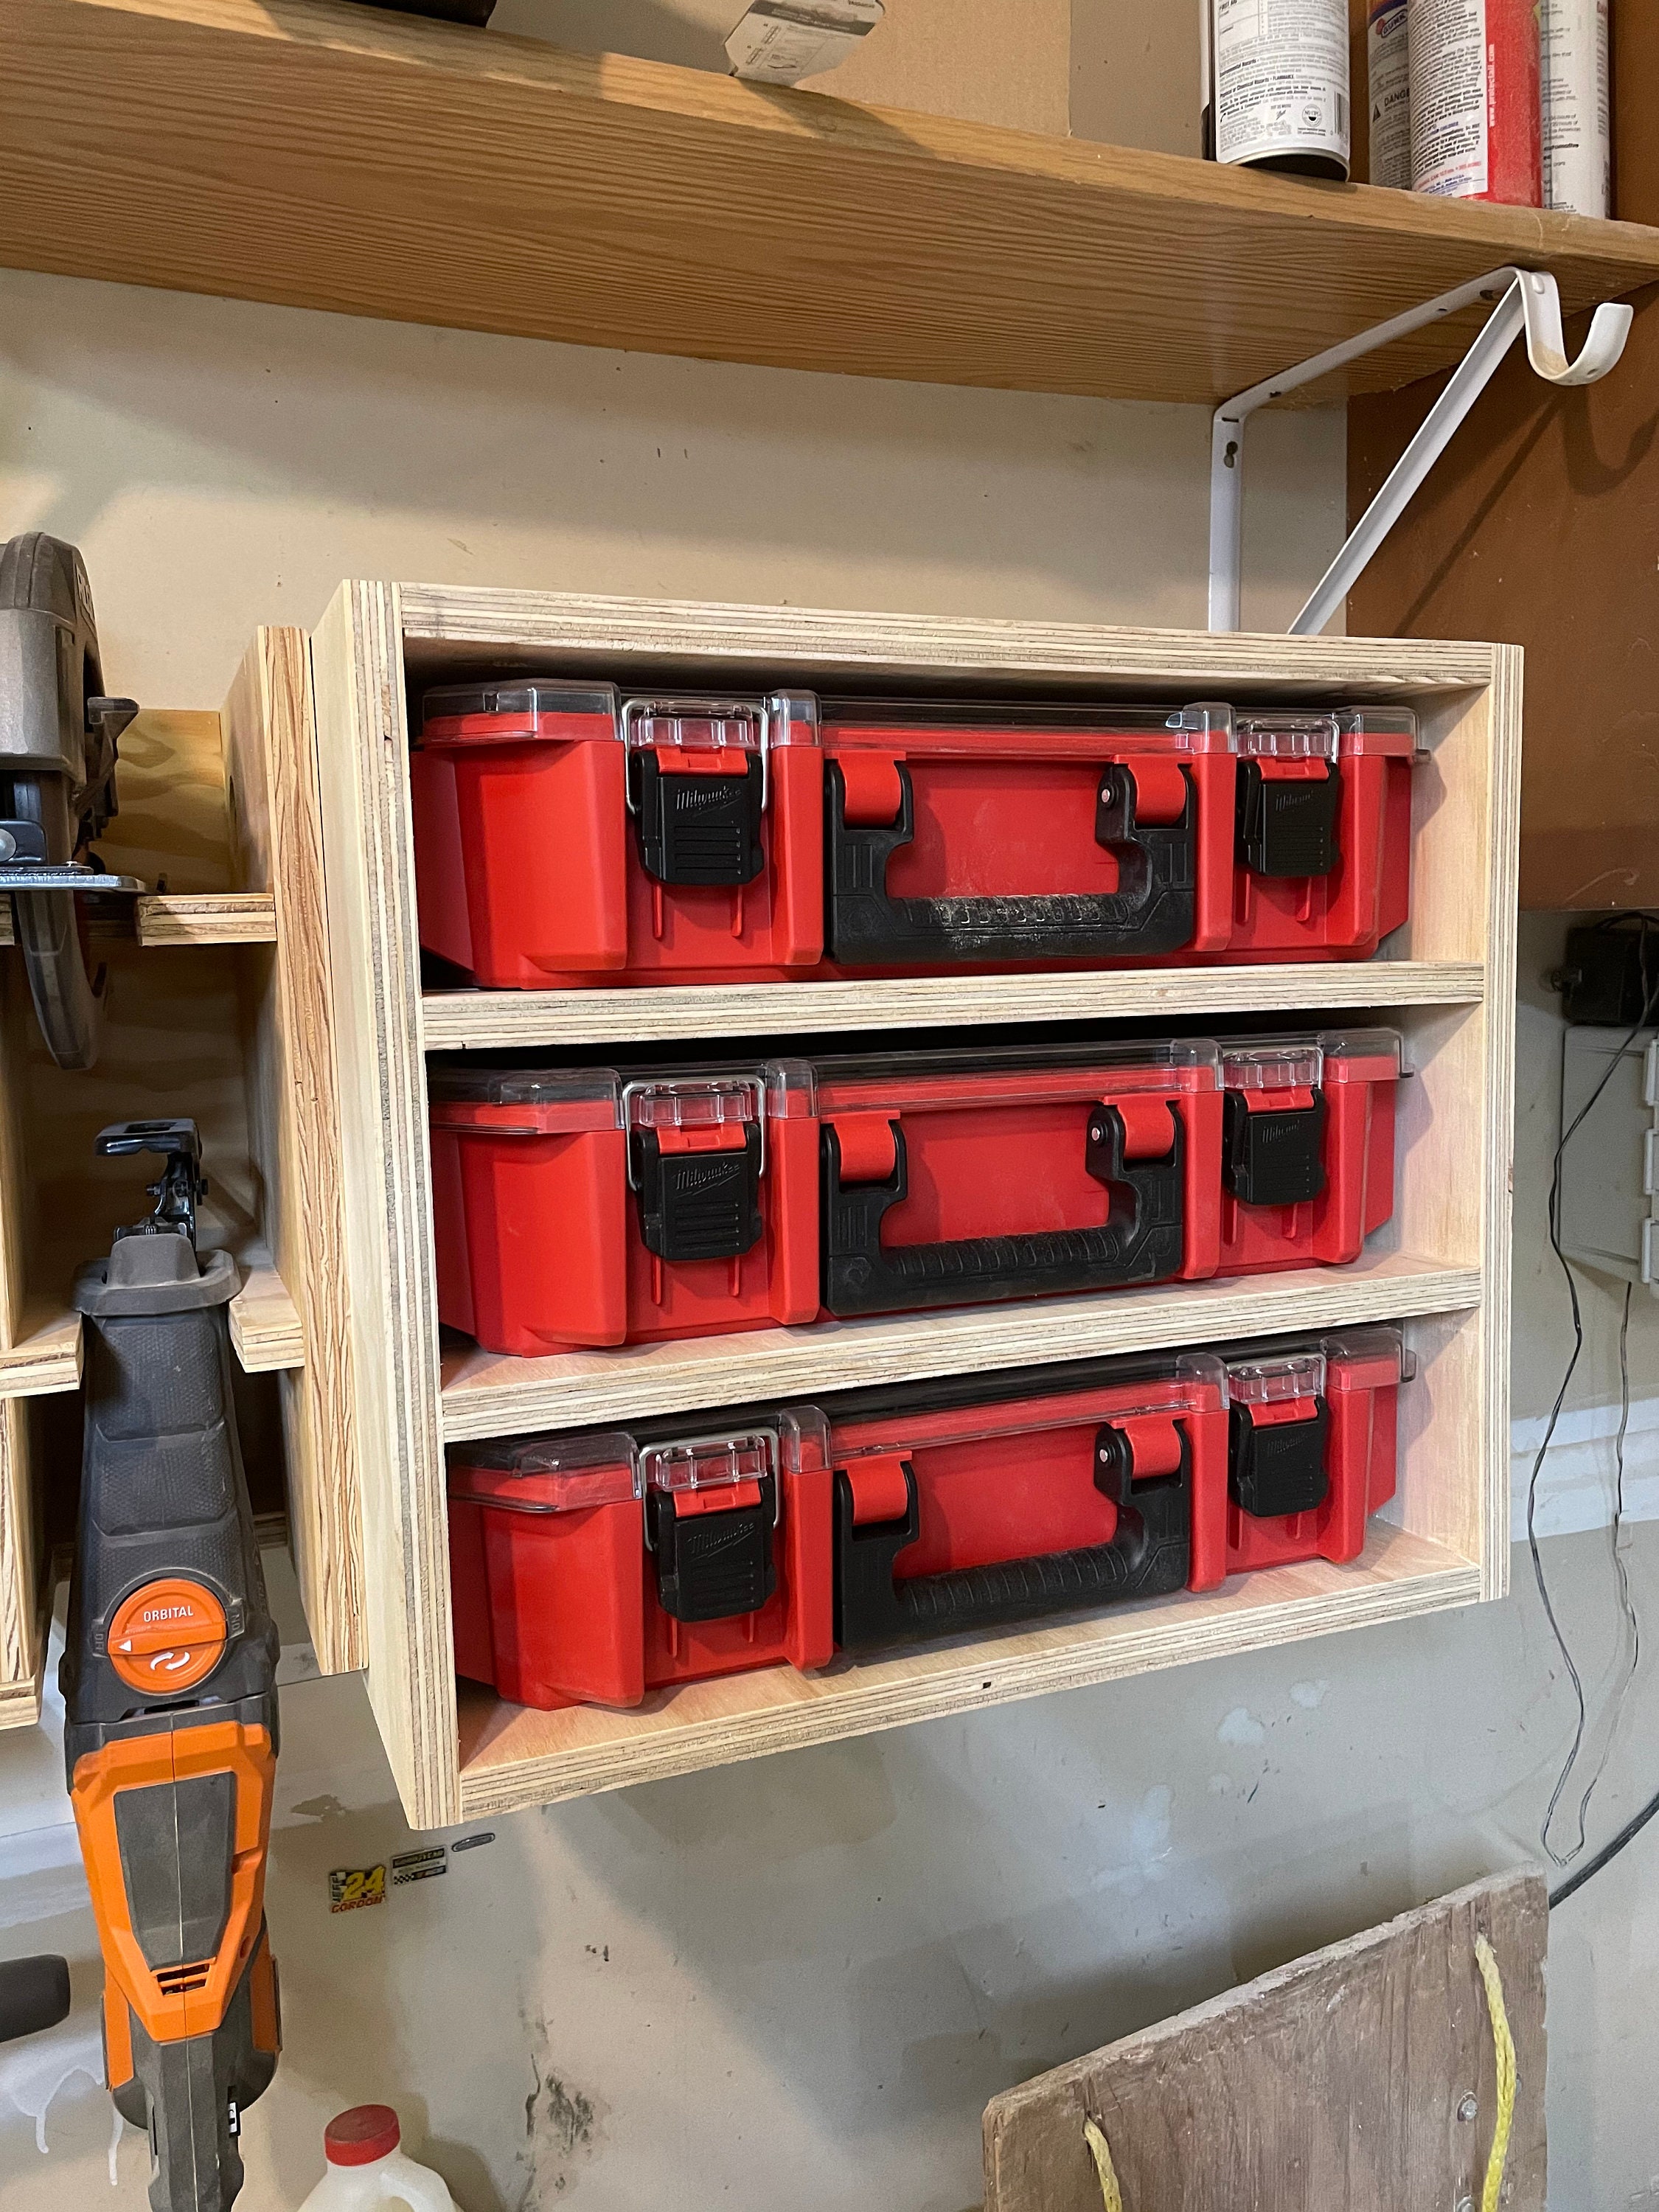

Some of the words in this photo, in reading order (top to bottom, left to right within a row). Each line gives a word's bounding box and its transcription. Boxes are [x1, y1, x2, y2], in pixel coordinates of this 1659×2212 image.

[1384, 88, 1410, 107] DANGE
[675, 785, 742, 810] Milwaukee
[672, 1161, 740, 1190] Milwaukee
[142, 1605, 194, 1623] ORBITAL
[343, 1865, 385, 1902] 24
[331, 1896, 383, 1913] GORDON
